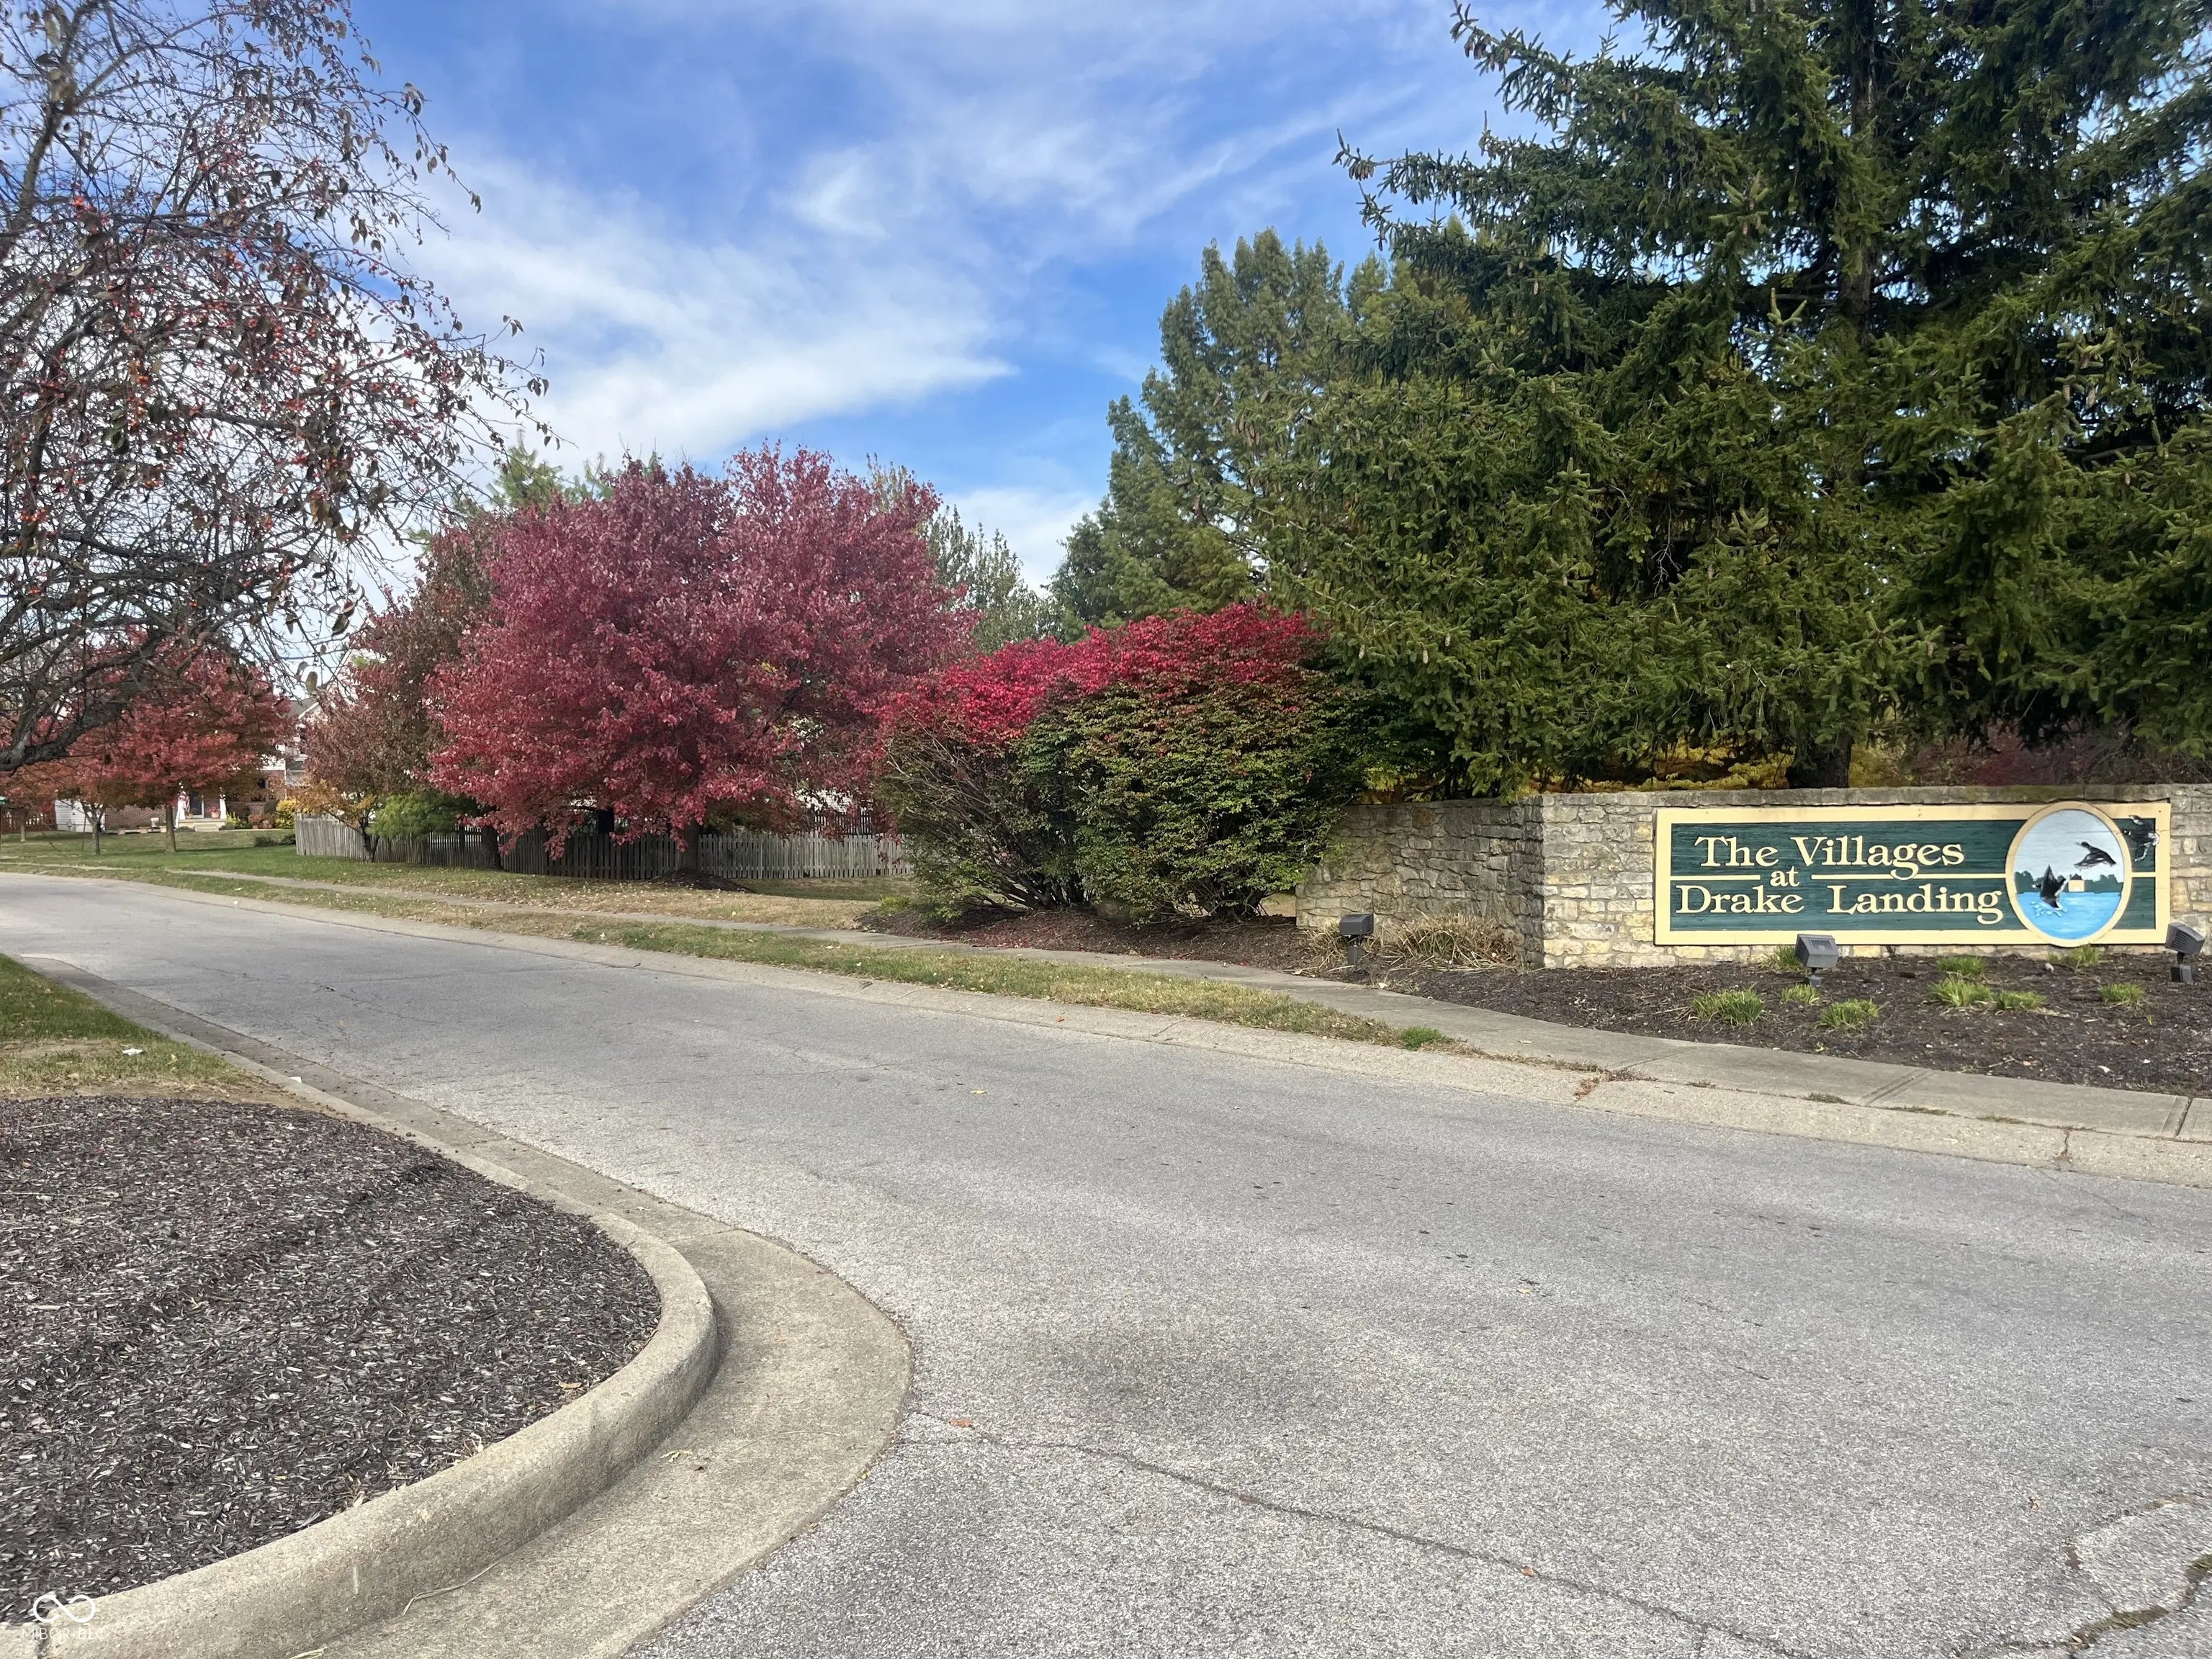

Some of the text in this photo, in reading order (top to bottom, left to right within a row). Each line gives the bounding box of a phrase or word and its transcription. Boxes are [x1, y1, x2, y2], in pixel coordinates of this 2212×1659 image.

[1694, 835, 1965, 881] The Villages
[1769, 866, 1800, 887] at
[1675, 883, 2004, 925] Drake Landing
